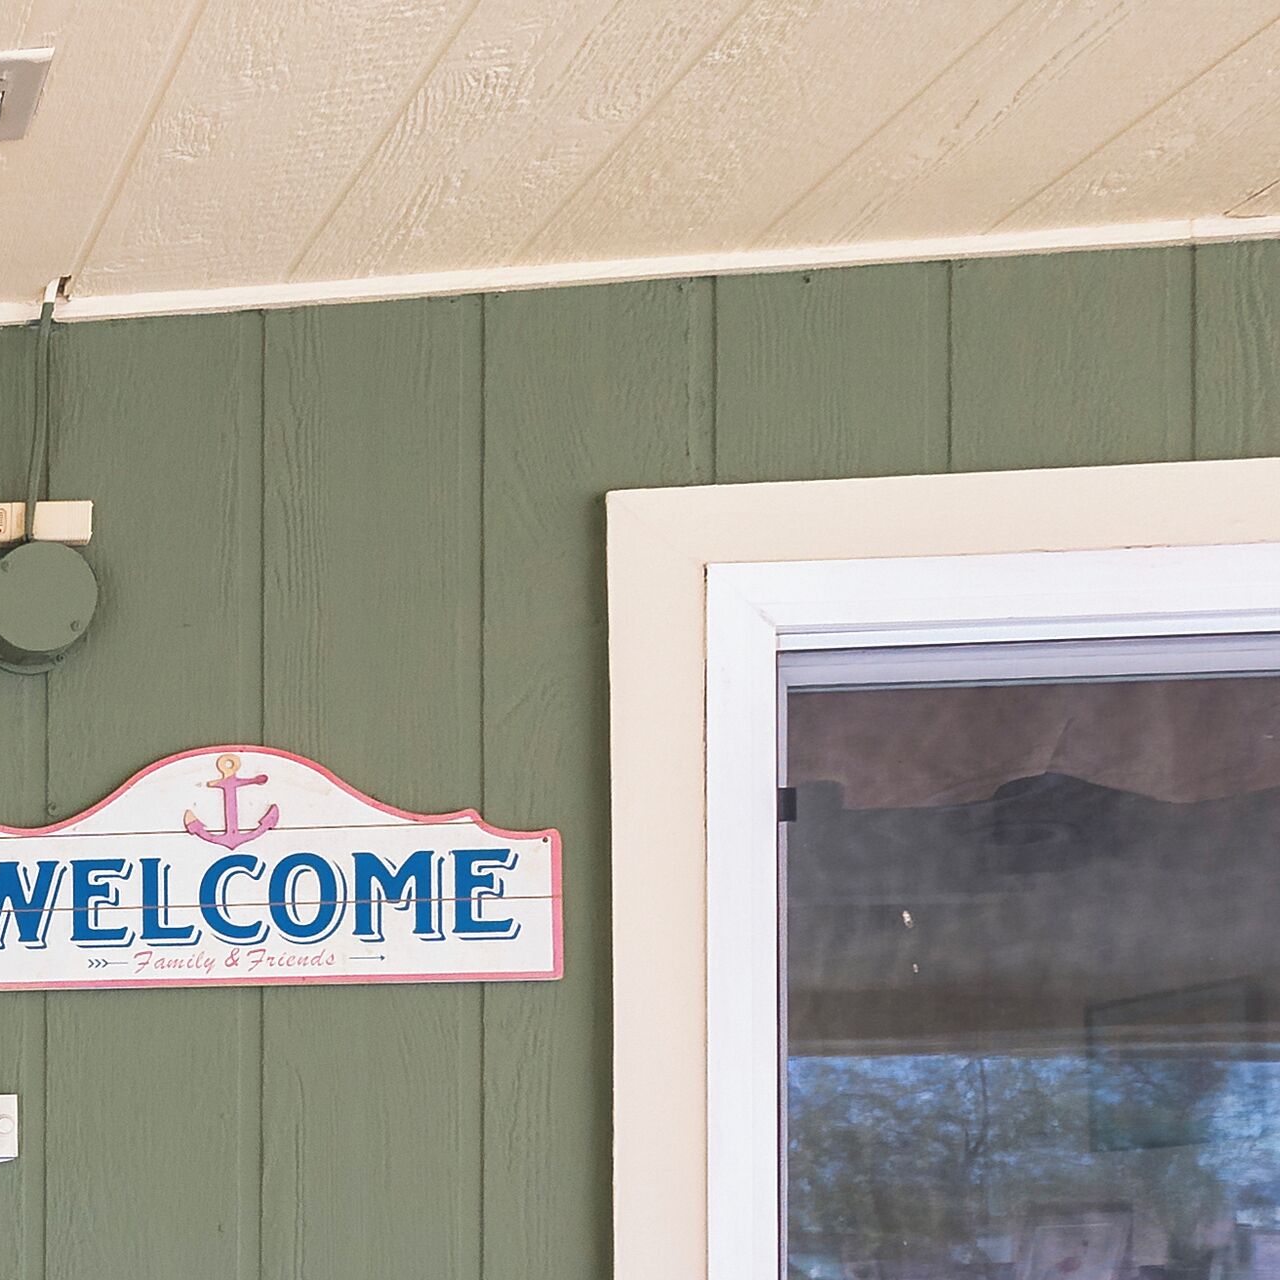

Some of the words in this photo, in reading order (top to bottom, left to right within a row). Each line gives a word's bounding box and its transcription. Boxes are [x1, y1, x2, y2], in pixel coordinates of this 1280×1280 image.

[134, 951, 216, 974] Family
[224, 948, 240, 968] &
[246, 948, 336, 972] Friends
